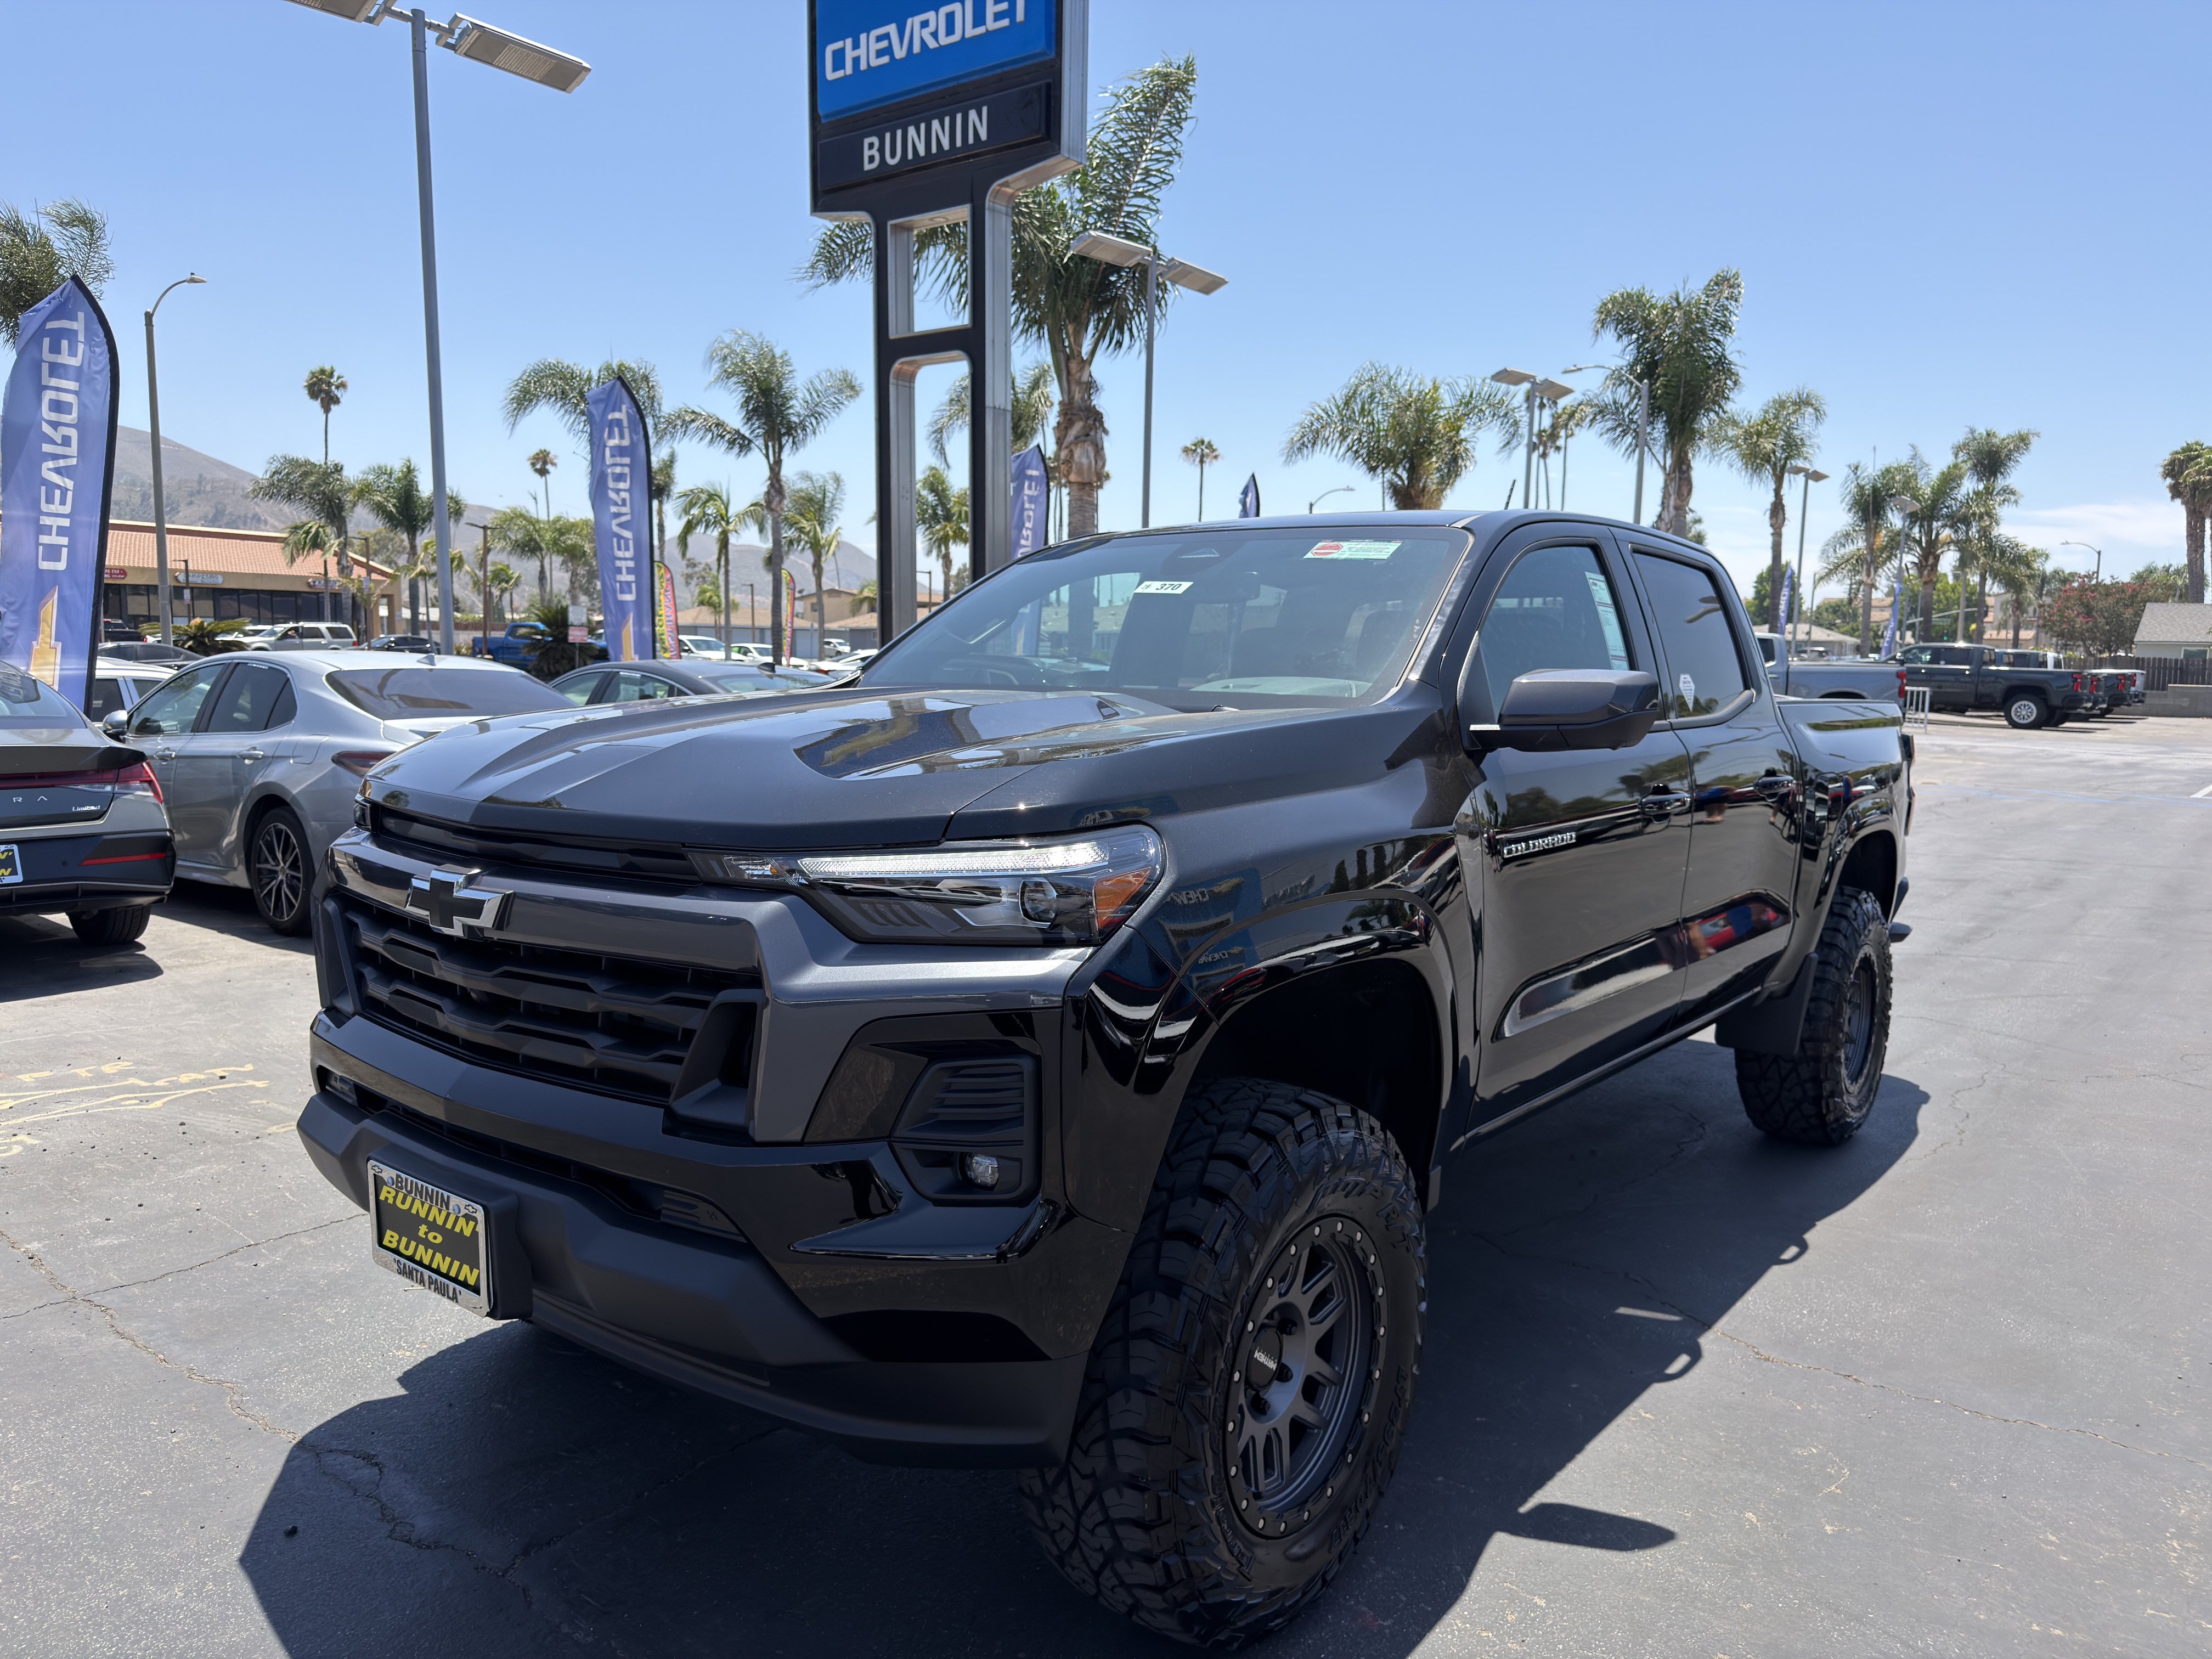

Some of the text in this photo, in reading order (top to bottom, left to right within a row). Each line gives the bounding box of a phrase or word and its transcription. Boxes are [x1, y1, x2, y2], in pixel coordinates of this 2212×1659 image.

[863, 106, 988, 171] BUNNIN
[1503, 831, 1576, 858] COLORADO
[395, 1174, 451, 1211] BUNNIN
[418, 1224, 443, 1244] to
[382, 1229, 479, 1286] BUNNIN
[1253, 1349, 1278, 1371] MAYHEM
